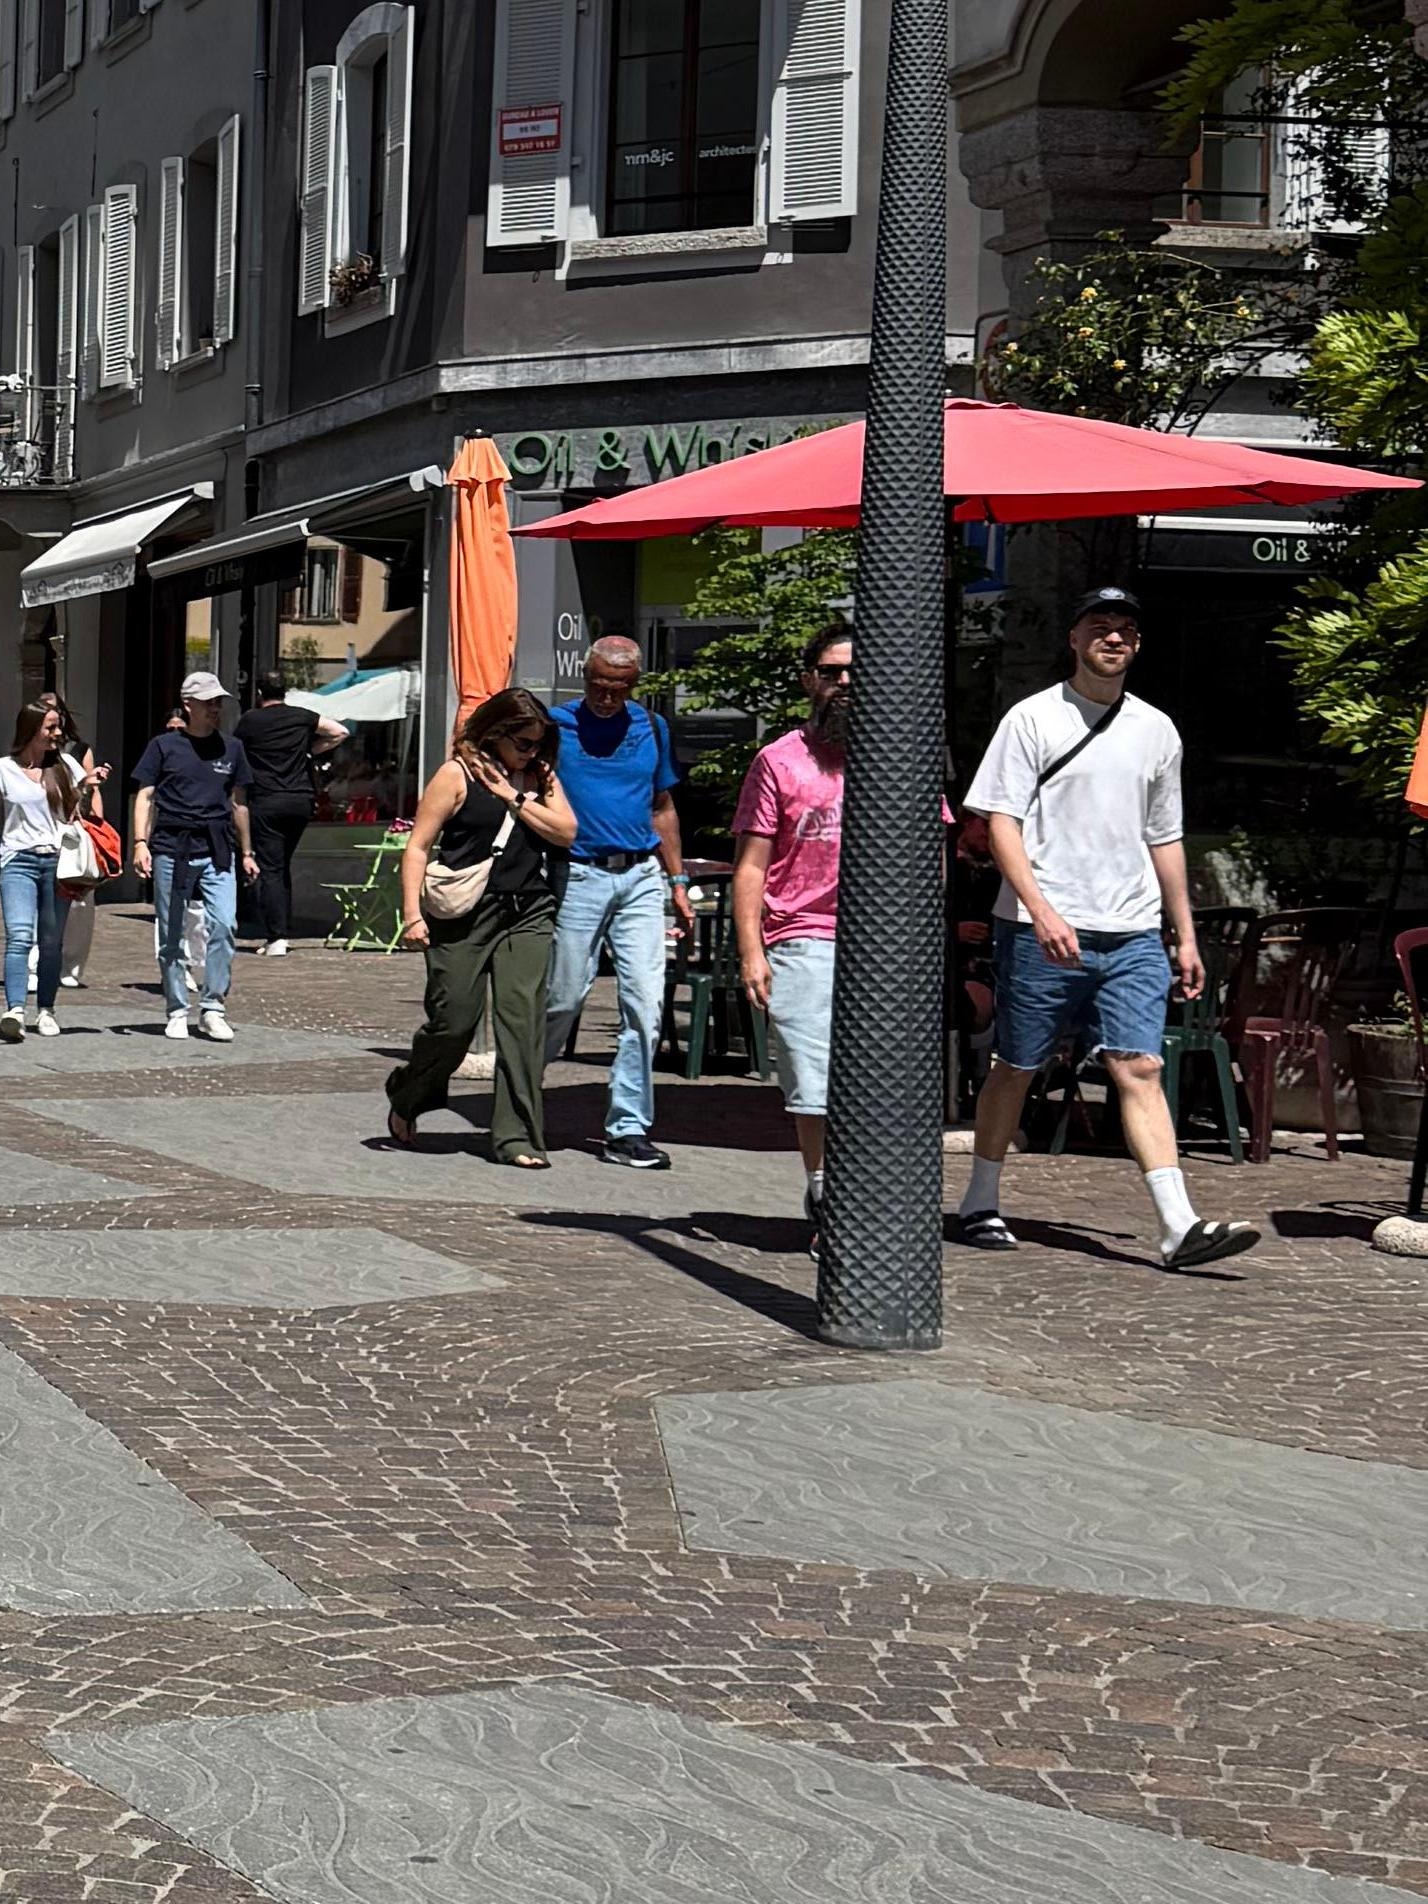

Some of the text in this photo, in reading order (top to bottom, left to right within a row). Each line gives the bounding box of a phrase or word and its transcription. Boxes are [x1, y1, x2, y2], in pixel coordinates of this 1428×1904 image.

[508, 431, 574, 474] Oil
[597, 431, 631, 472] &
[1252, 537, 1288, 562] Oil
[1294, 538, 1312, 563] &
[557, 612, 582, 641] Oil
